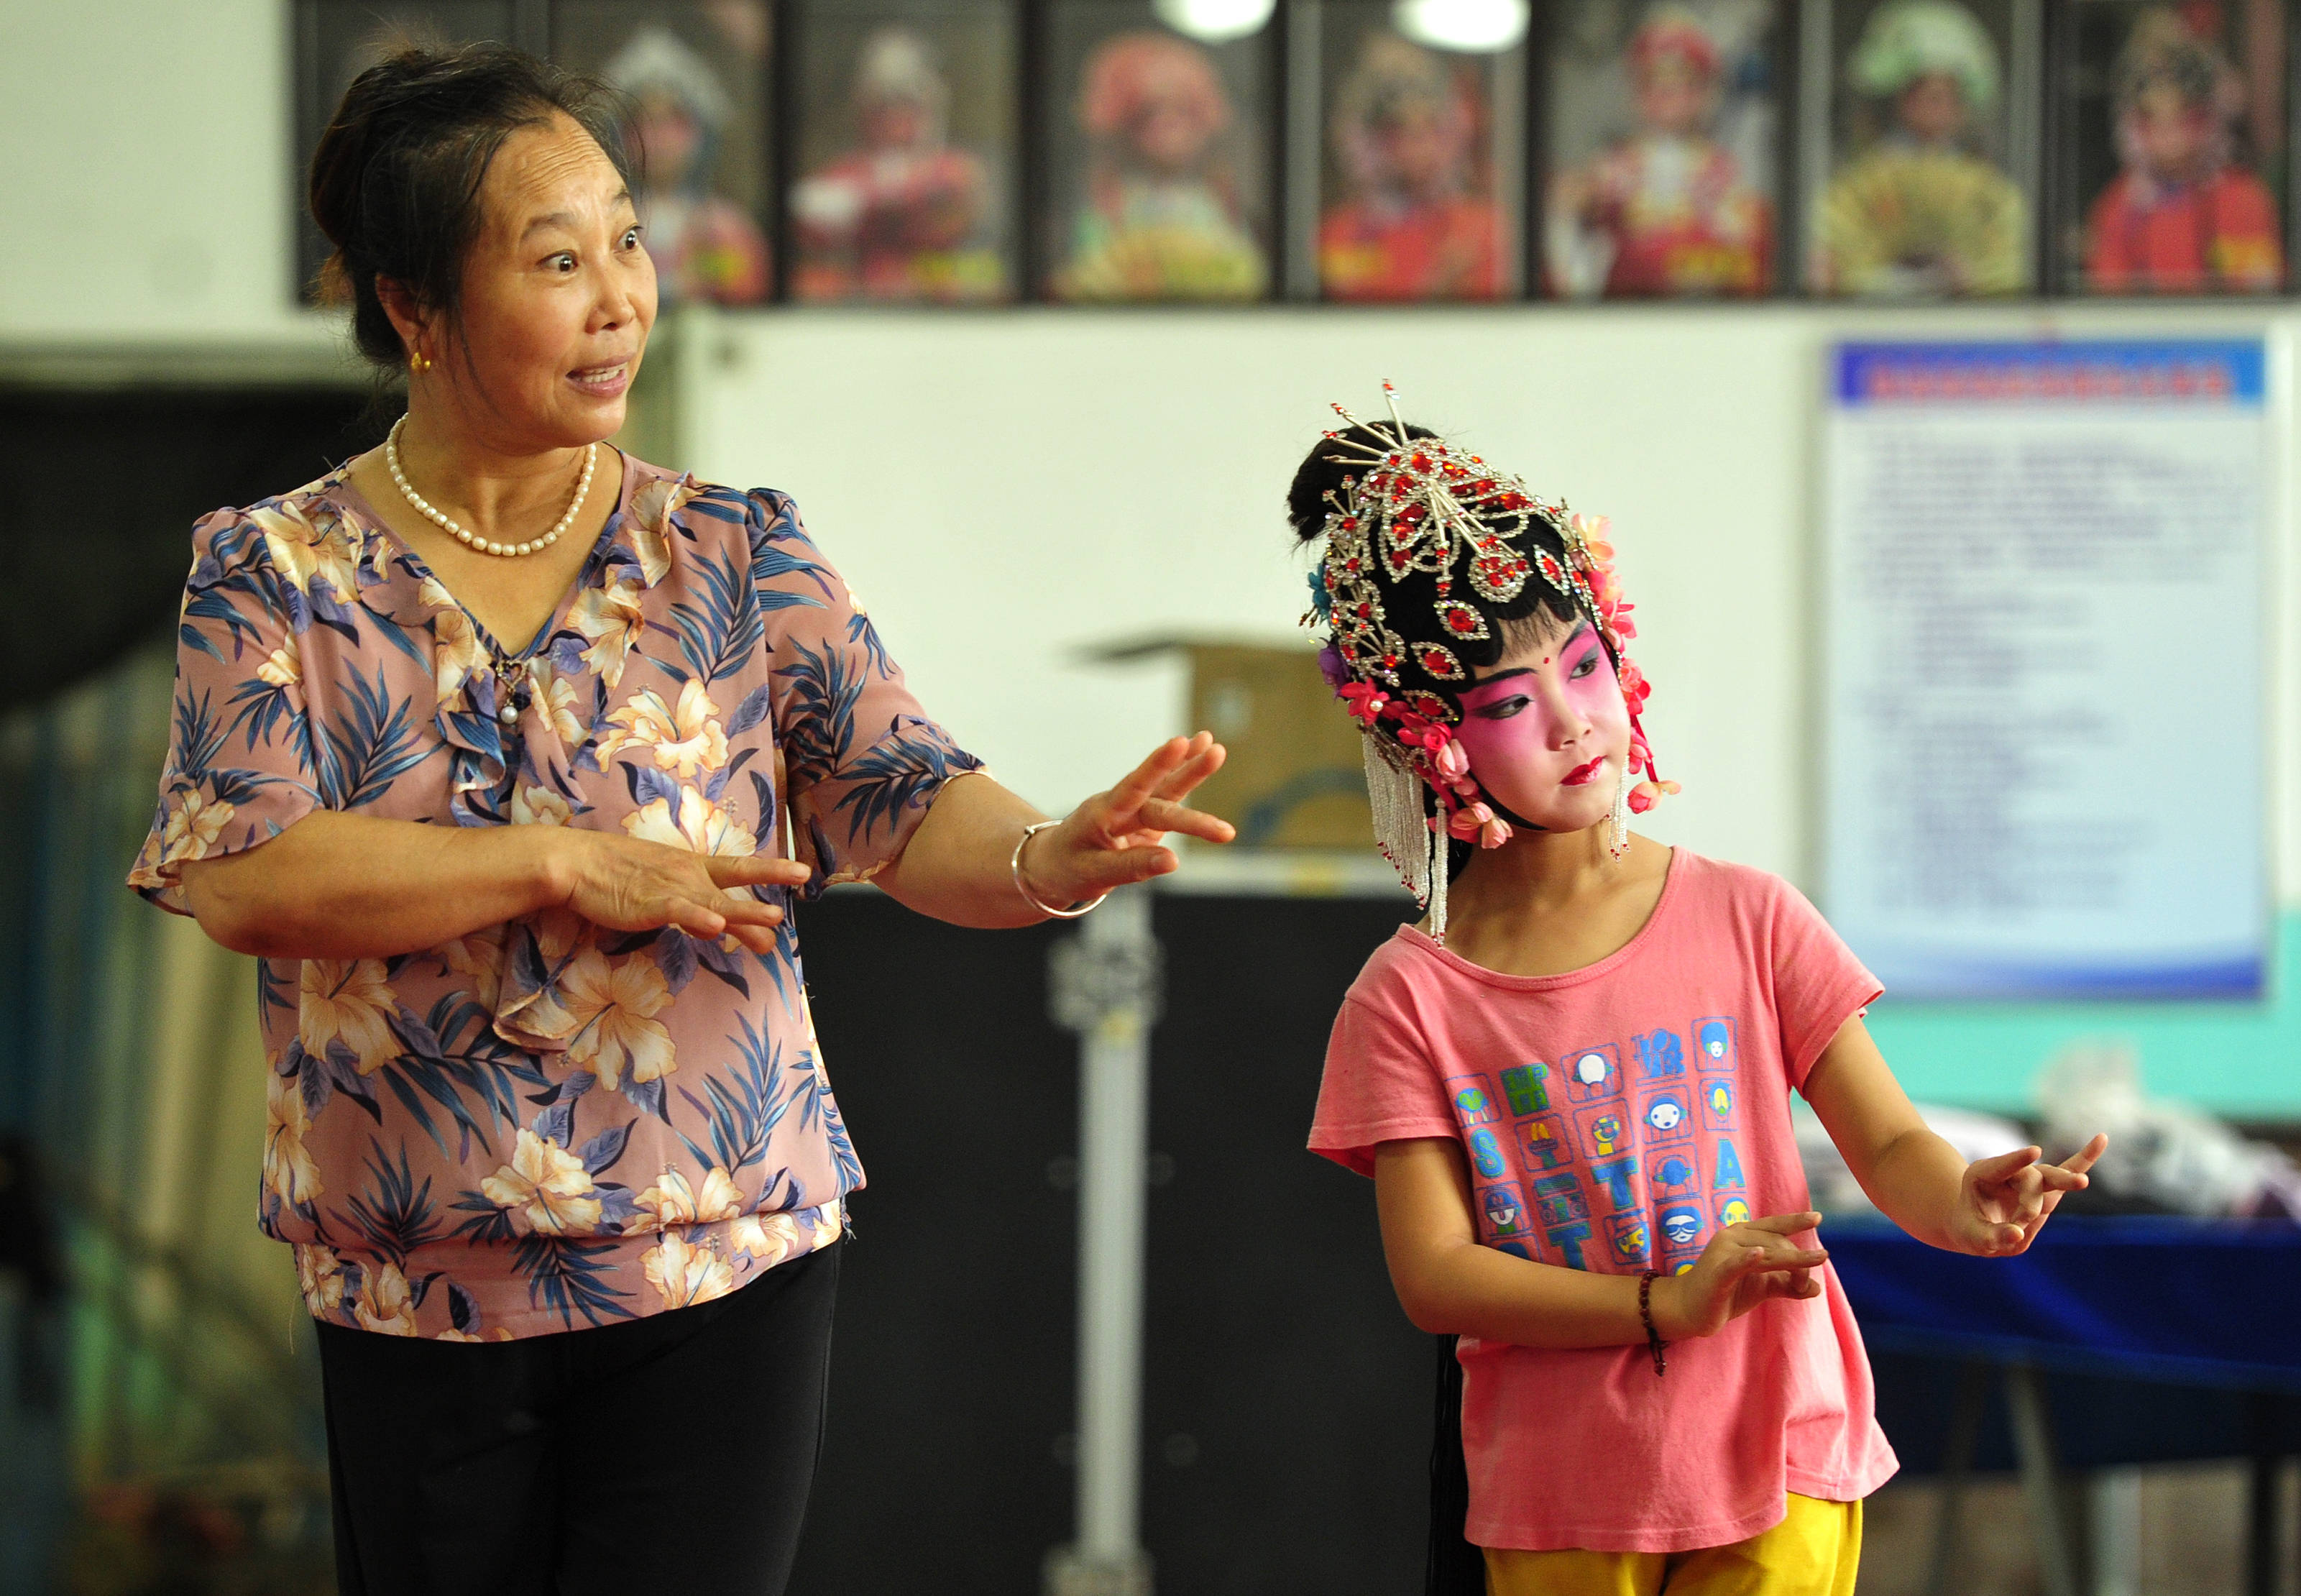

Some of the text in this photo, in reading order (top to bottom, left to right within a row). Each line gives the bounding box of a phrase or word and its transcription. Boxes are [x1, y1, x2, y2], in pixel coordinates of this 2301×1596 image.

[1470, 1128, 1506, 1178] S
[1712, 1138, 1746, 1190] A
[1591, 1155, 1640, 1211] T
[1546, 1221, 1592, 1271] T
